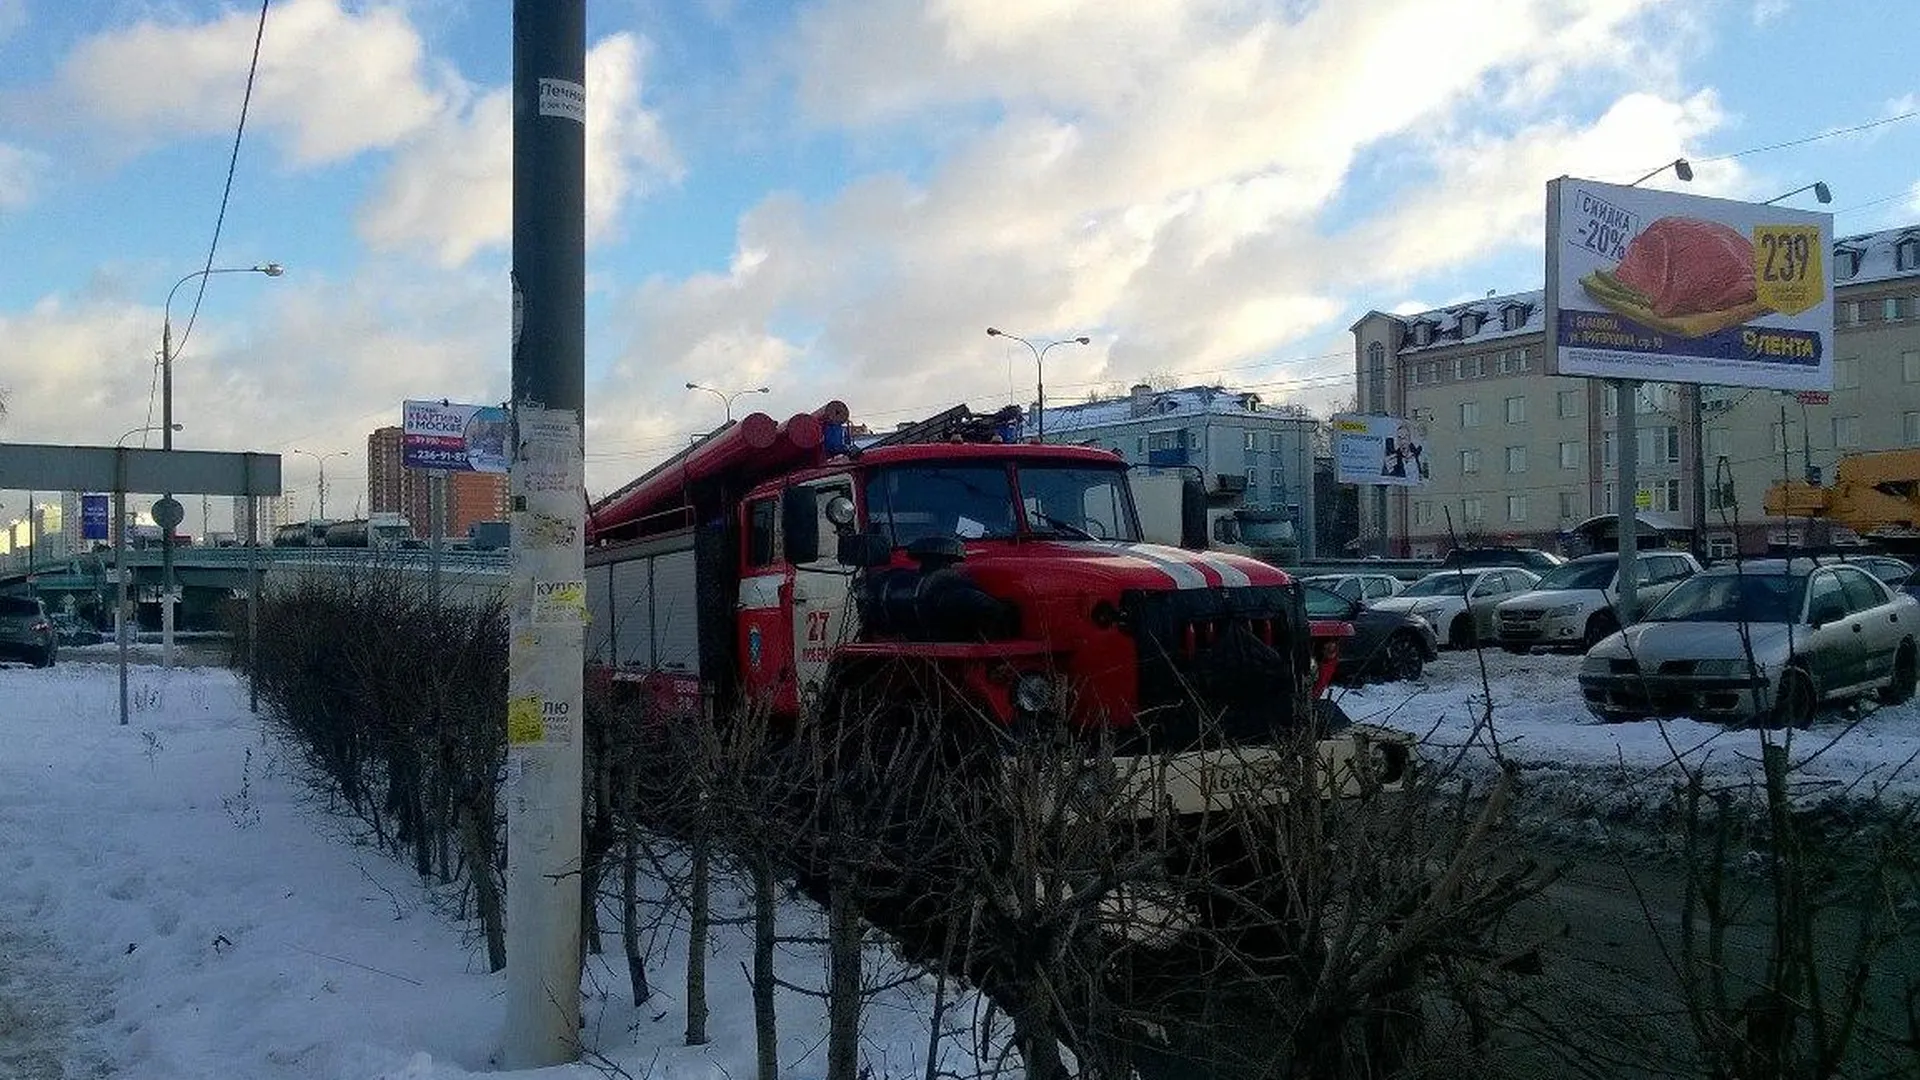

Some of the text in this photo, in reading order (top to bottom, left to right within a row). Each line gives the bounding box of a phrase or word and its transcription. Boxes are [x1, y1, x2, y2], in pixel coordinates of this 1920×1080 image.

[1582, 196, 1630, 232] СКИДКА
[1577, 218, 1626, 260] -20%
[1761, 232, 1810, 282] 239
[415, 421, 462, 433] МОСКВЕ
[807, 611, 830, 642] 27
